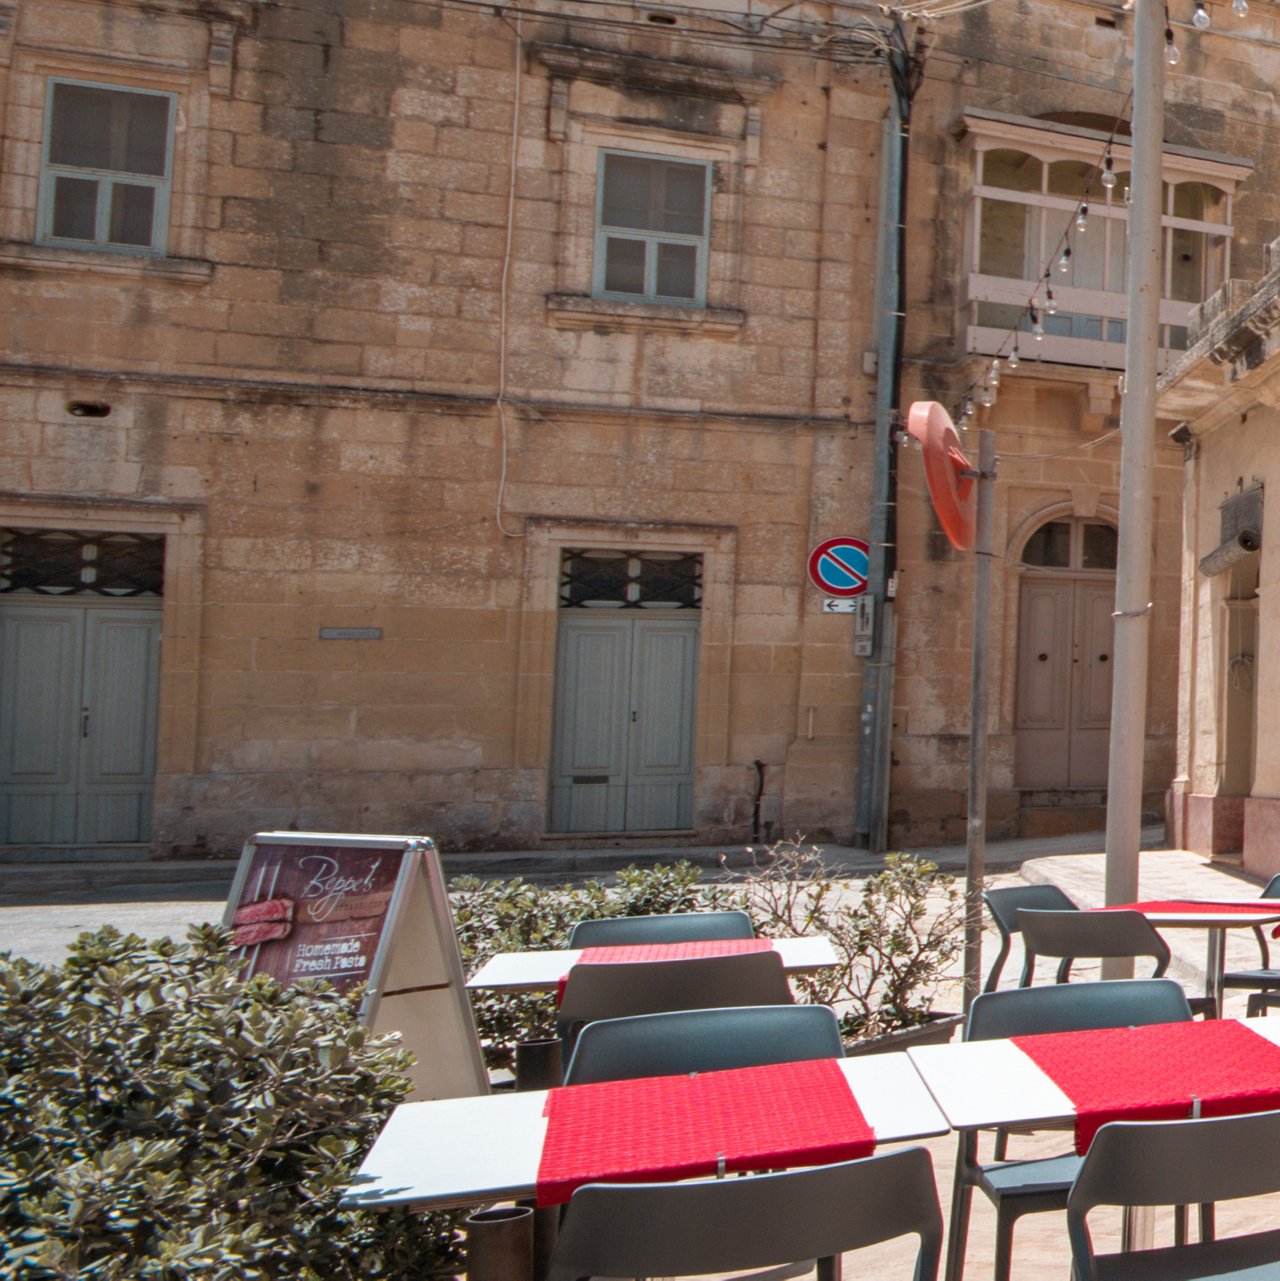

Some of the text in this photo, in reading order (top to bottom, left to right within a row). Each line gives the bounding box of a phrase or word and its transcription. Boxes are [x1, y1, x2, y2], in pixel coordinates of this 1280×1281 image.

[296, 938, 361, 957] Homemade
[293, 954, 367, 973] Fresh Pasta
